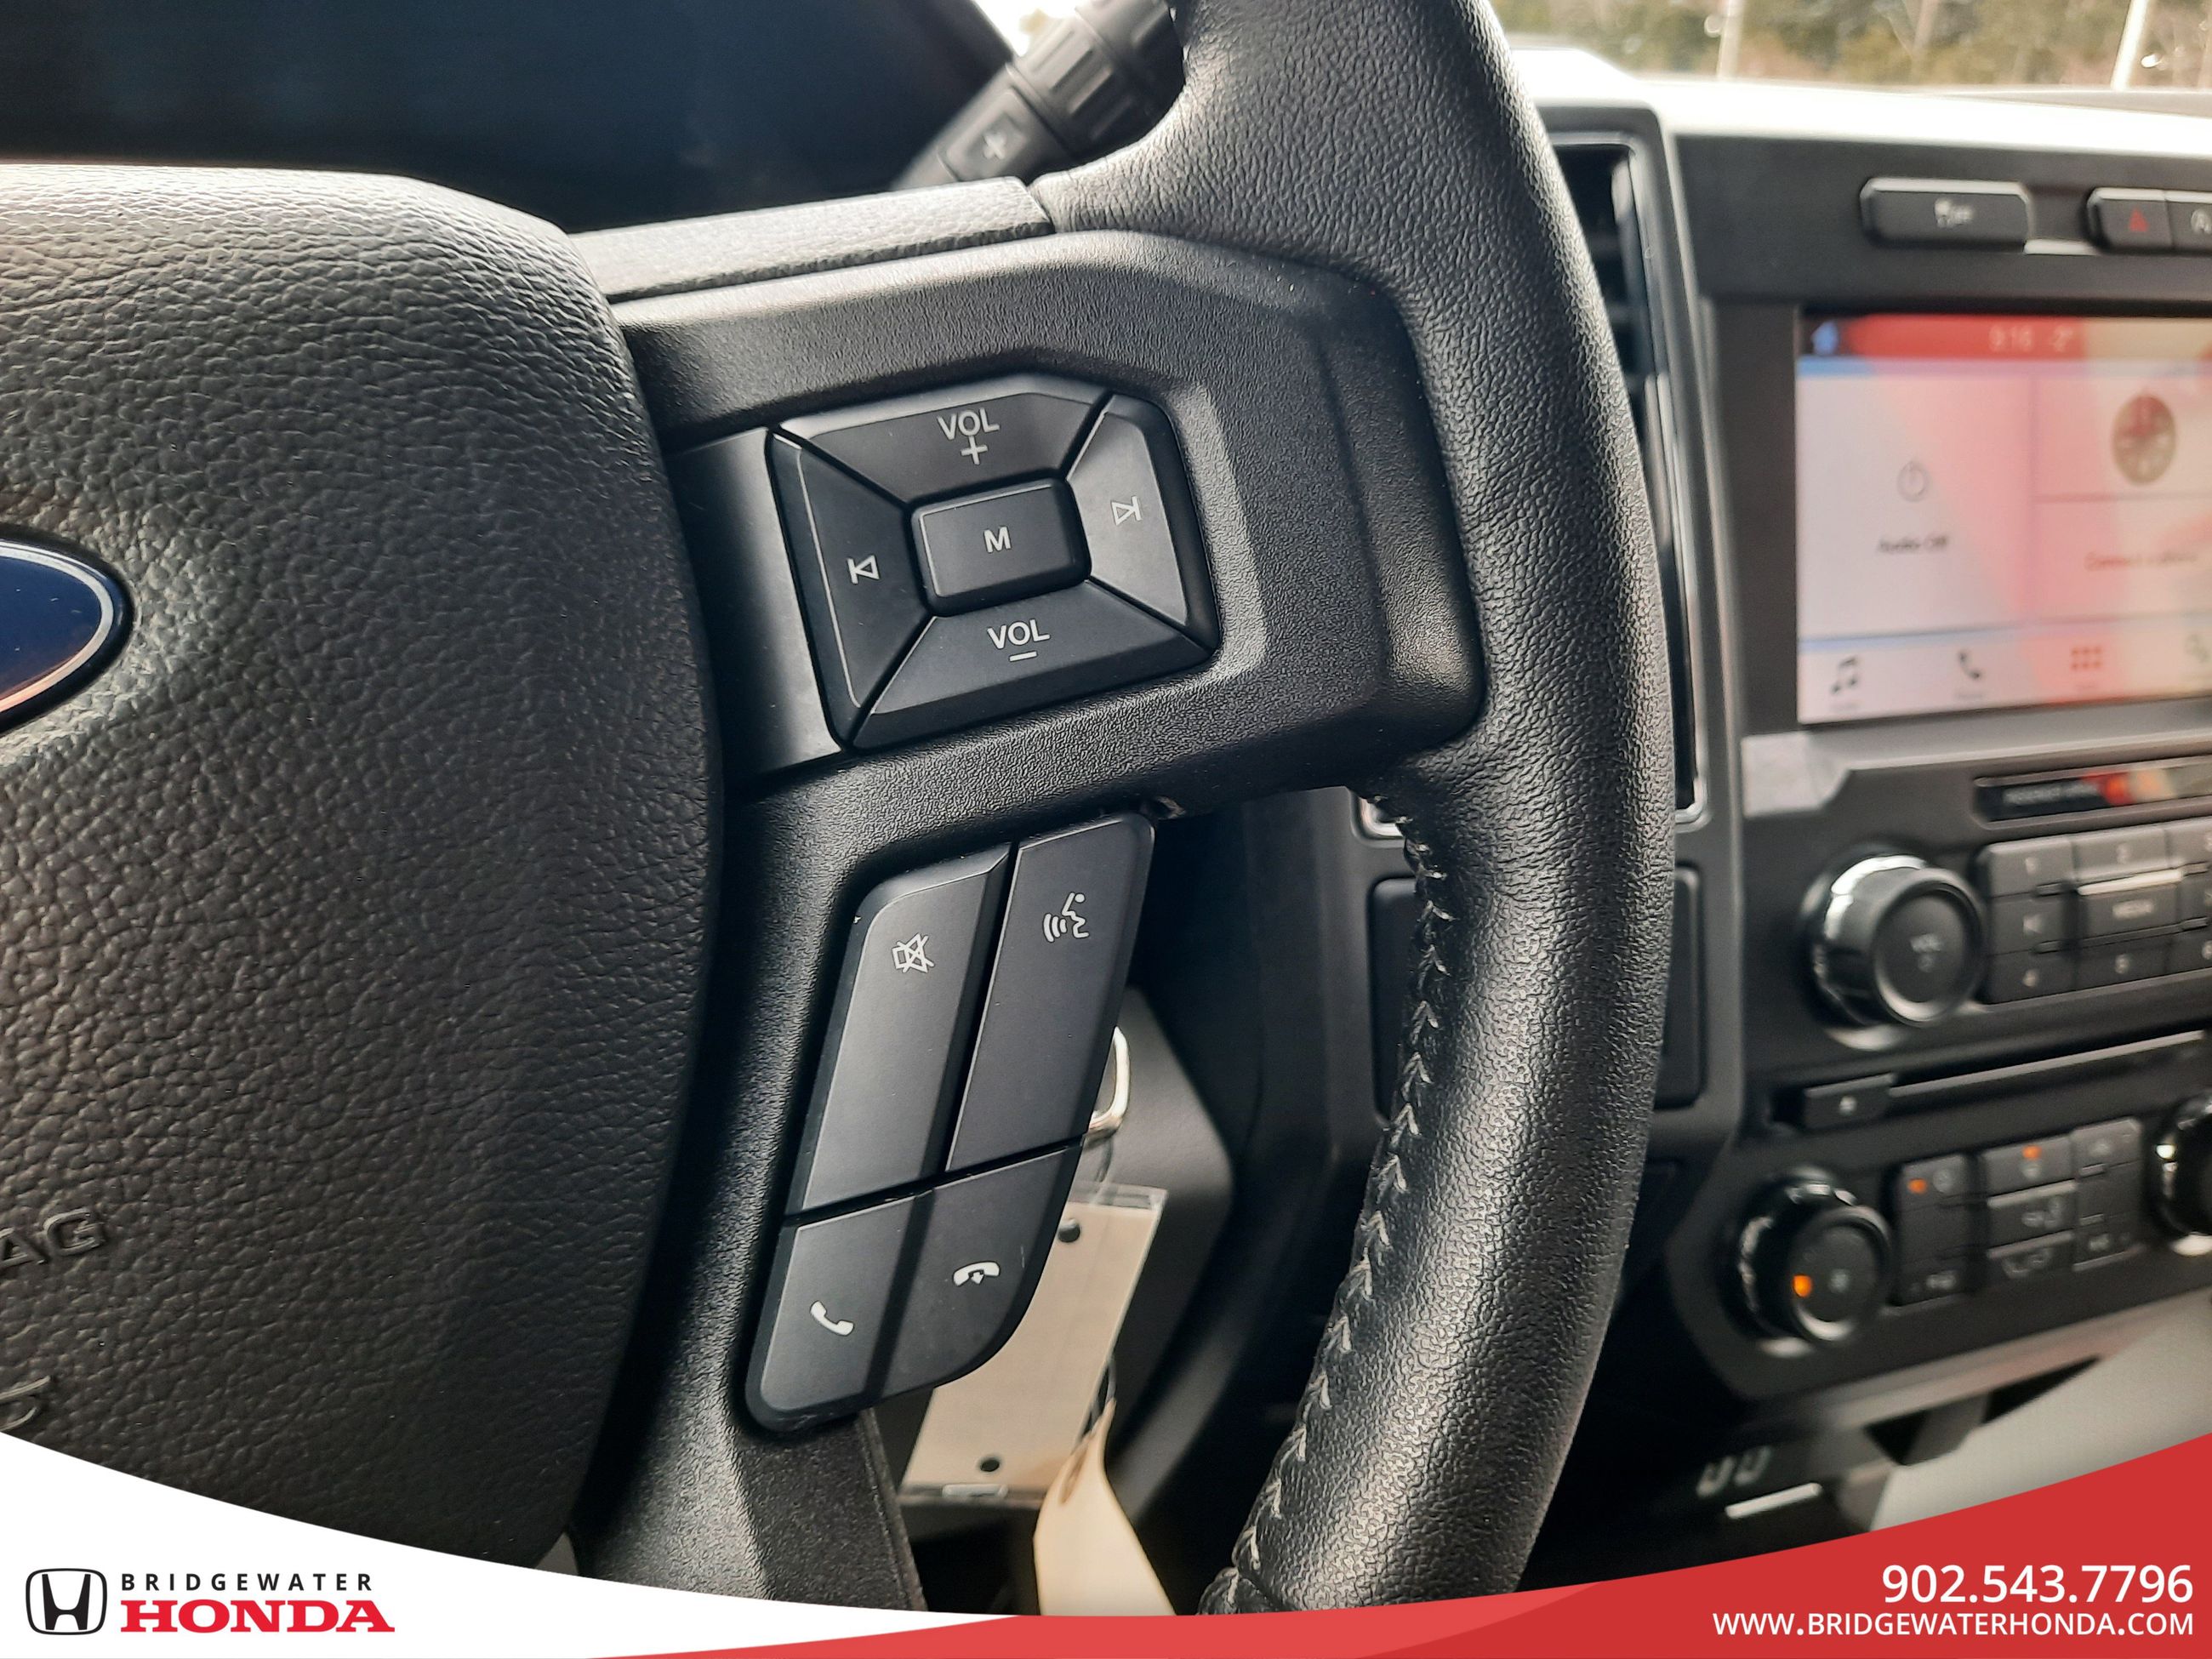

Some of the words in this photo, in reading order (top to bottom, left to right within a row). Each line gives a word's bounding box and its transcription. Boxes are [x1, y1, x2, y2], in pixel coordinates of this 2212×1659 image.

[938, 408, 1000, 441] VOL
[983, 526, 1012, 553] M
[987, 619, 1051, 650] VOL
